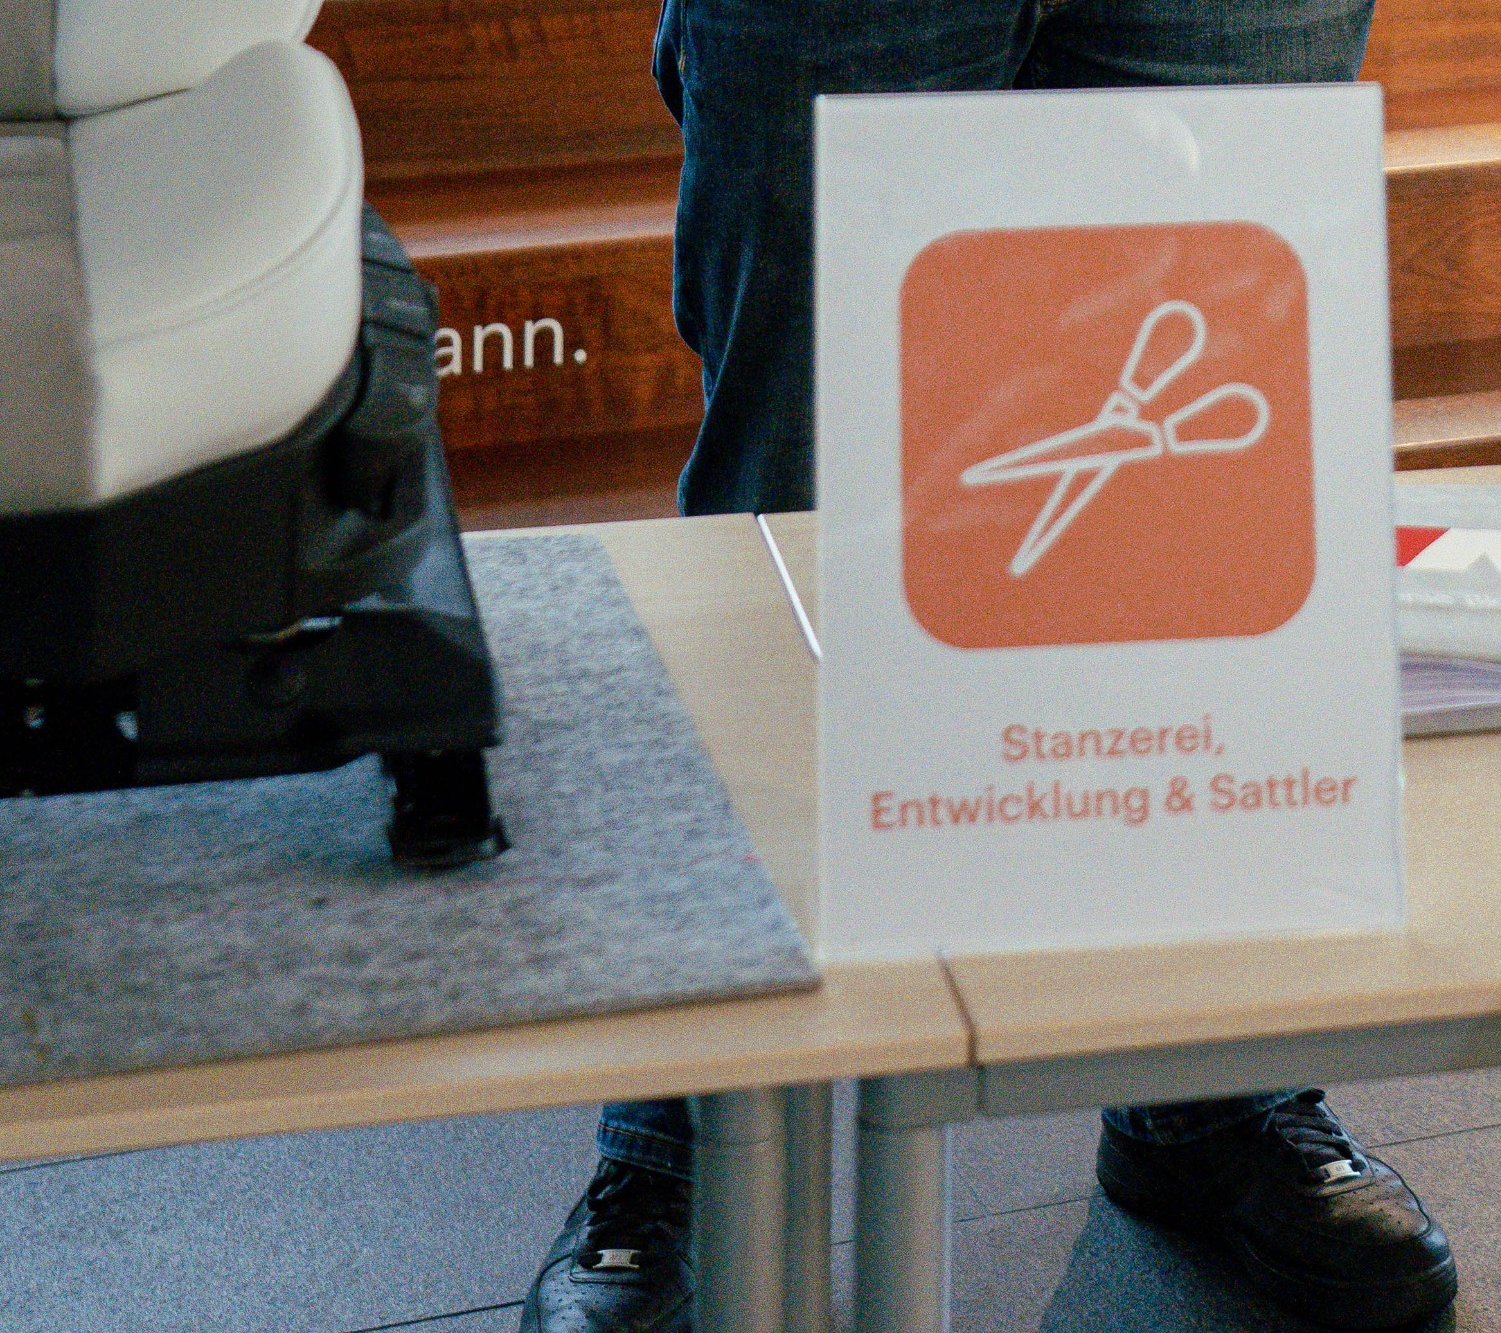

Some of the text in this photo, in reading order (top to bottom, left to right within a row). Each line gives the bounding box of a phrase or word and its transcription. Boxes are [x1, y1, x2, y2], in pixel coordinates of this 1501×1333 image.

[1001, 713, 1227, 764] Stanzerei,
[869, 767, 1359, 831] Entwicklung & Sattler
